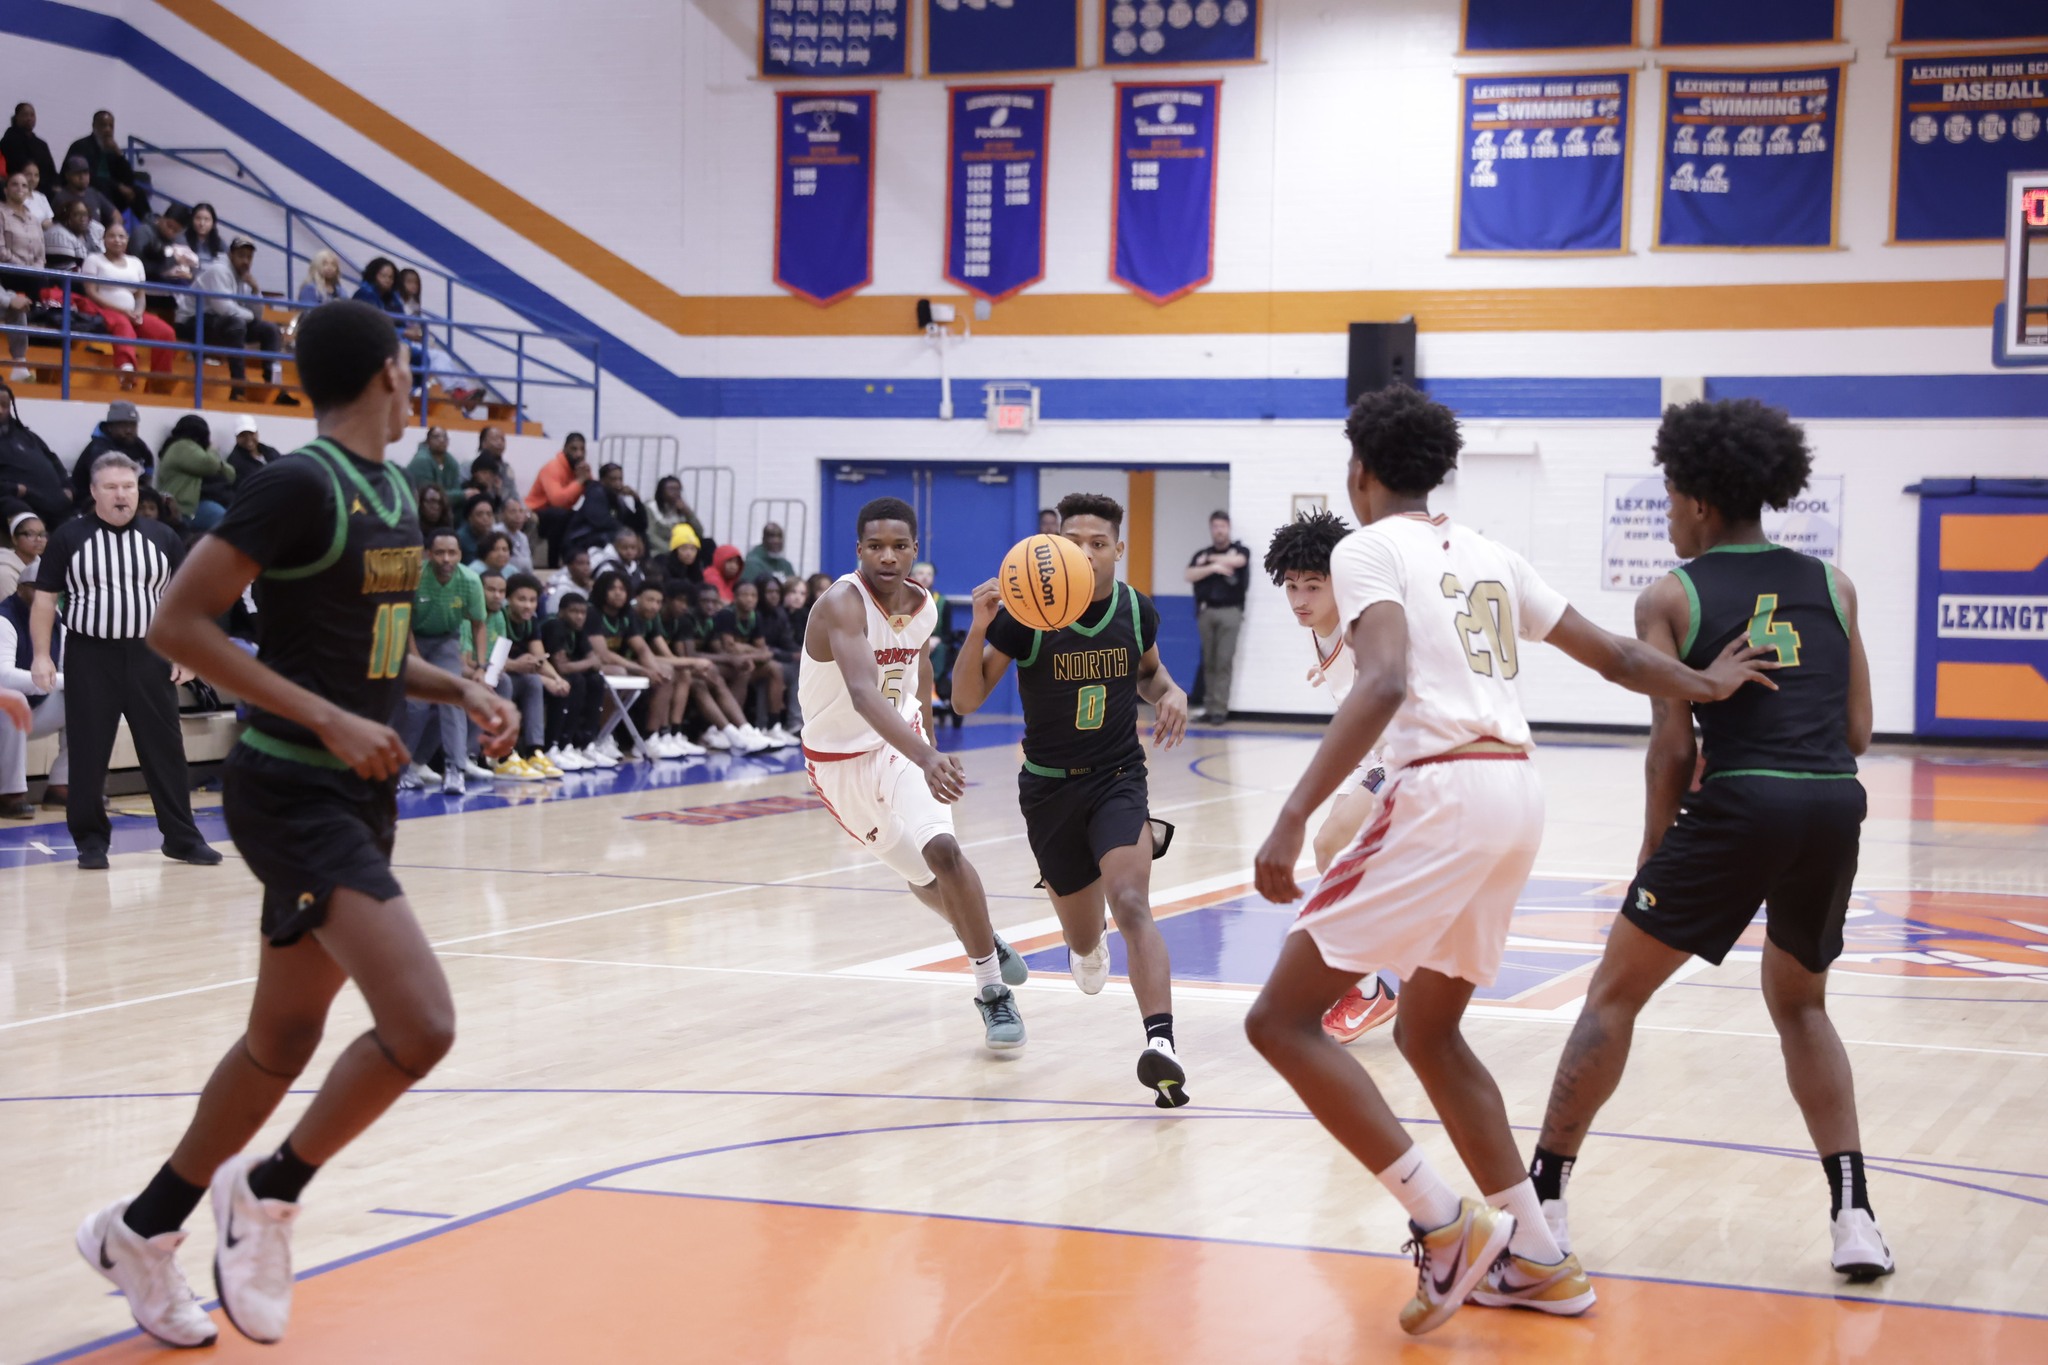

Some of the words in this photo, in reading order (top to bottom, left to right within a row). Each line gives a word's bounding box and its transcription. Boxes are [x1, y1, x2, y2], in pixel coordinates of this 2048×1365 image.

[1912, 65, 1988, 79] LEXINGTON
[1992, 63, 2022, 76] HIGH
[1473, 84, 1542, 99] LEXINGTON
[1544, 84, 1574, 97] HIGH
[1576, 81, 1620, 96] SCHOOL
[1675, 79, 1746, 93] LEXINGTON
[1749, 79, 1779, 93] HIGH
[1782, 78, 1828, 92] SCHOOL
[1942, 81, 2045, 102] BASEBALL
[1497, 101, 1594, 120] SWIMMING
[1700, 97, 1801, 115] SWIMMING
[975, 128, 1022, 138] FOOTBALL
[1034, 544, 1056, 607] Wilson
[1440, 571, 1519, 680] 20
[1942, 604, 2048, 630] LEXINGT
[367, 602, 412, 680] 10
[1746, 593, 1801, 667] 4
[1053, 647, 1129, 681] NORTH
[1075, 684, 1107, 730] 0
